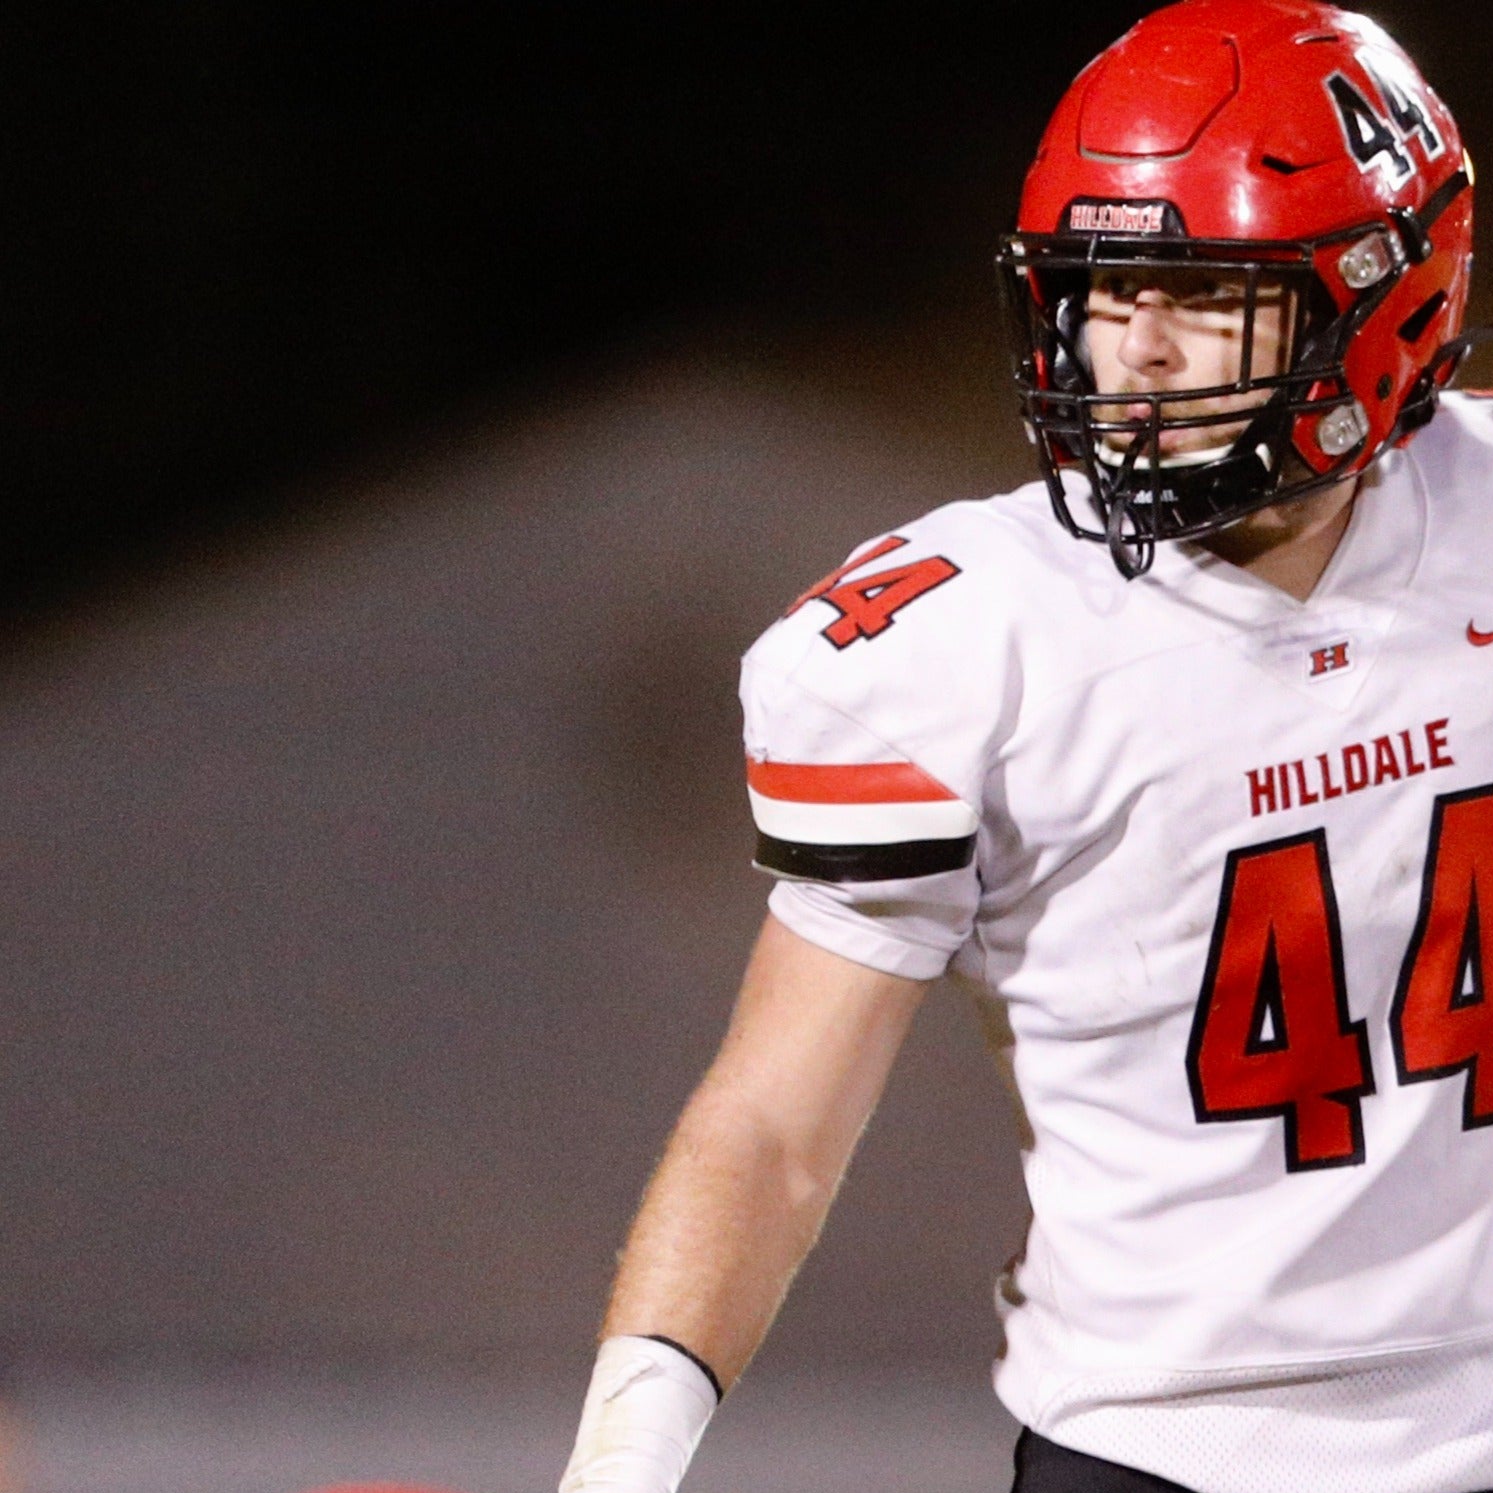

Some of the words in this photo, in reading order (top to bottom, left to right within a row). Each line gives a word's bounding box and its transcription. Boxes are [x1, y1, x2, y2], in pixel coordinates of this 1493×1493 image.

[1322, 50, 1447, 192] 44
[781, 535, 963, 652] 4
[1310, 641, 1349, 677] H
[1245, 718, 1455, 818] HILLDALE
